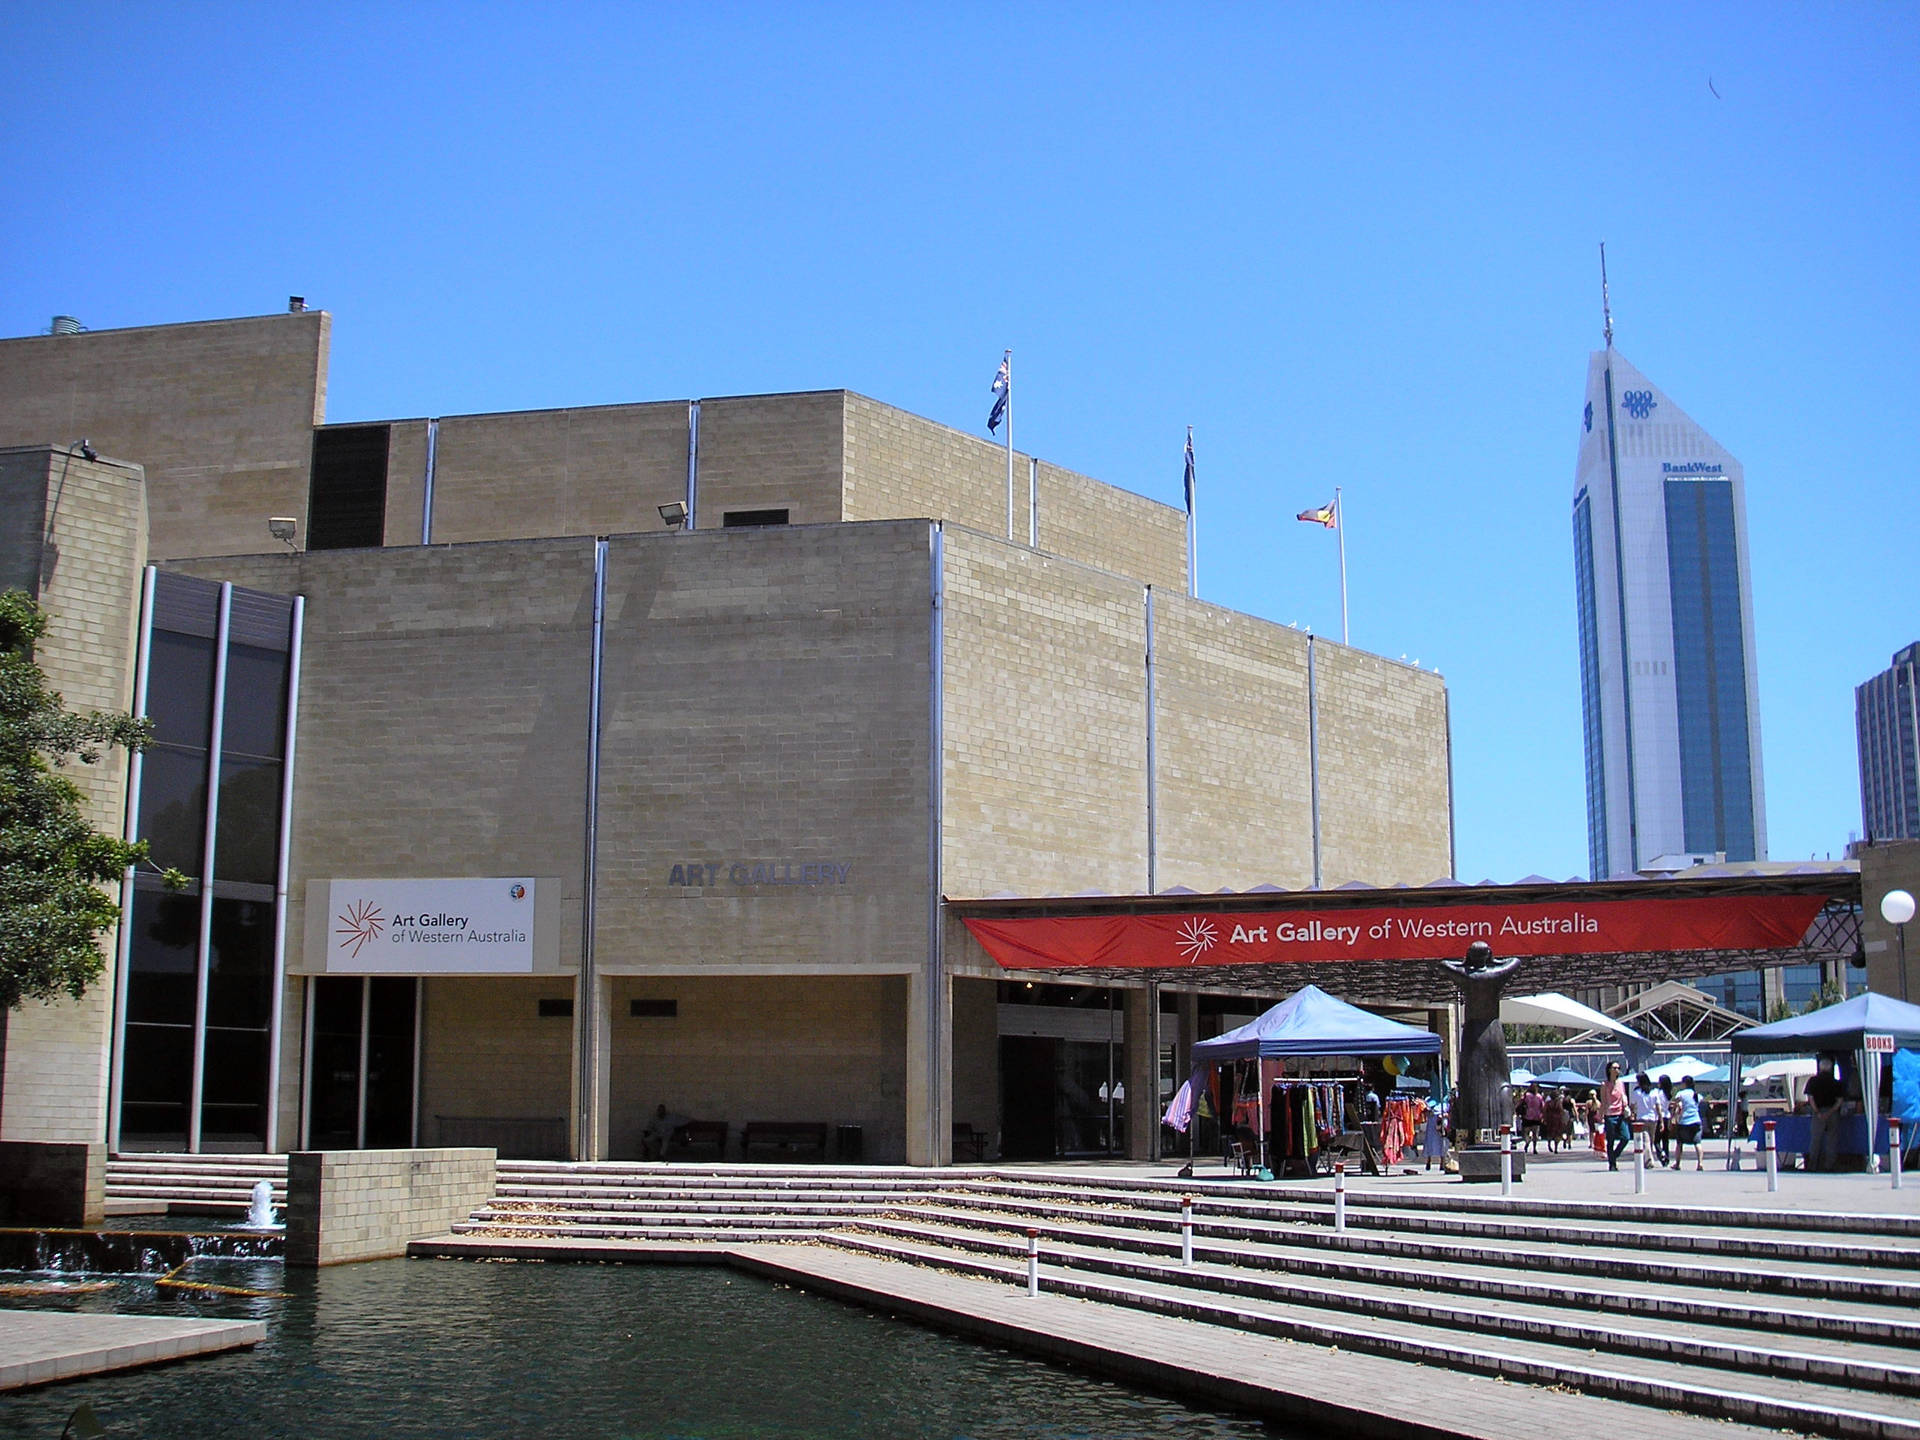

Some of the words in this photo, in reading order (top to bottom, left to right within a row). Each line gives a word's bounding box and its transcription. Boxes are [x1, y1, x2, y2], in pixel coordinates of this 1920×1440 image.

[1663, 462, 1723, 473] BankWest
[668, 864, 720, 886] ART
[729, 862, 850, 886] GALLERY
[392, 914, 415, 927] Art
[419, 913, 469, 929] Gallery
[1230, 924, 1268, 943] Art
[1276, 920, 1360, 945] Gallery
[1369, 918, 1391, 939] of
[1398, 917, 1492, 938] Western
[1500, 912, 1598, 936] Australia
[392, 929, 406, 943] of
[408, 930, 464, 943] Western
[467, 929, 526, 943] Australia
[1866, 1037, 1892, 1049] BOOKS
